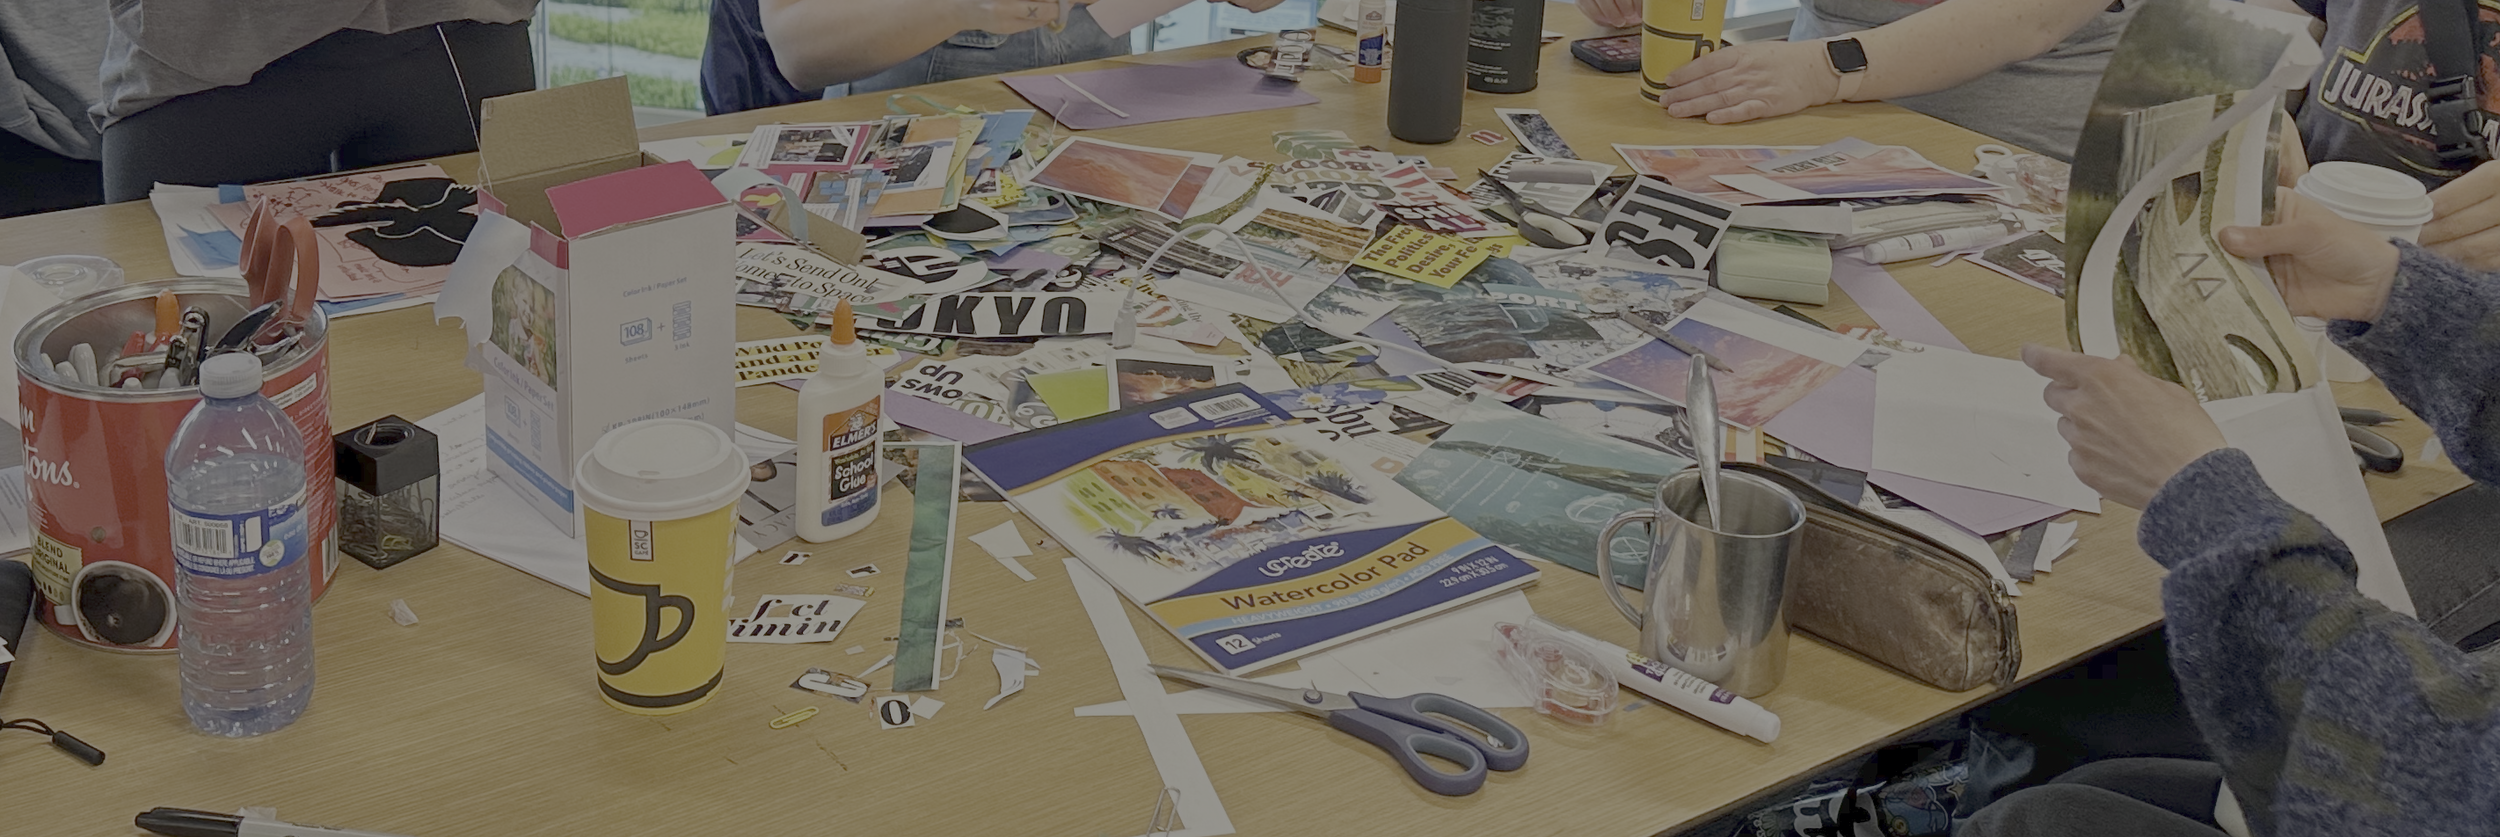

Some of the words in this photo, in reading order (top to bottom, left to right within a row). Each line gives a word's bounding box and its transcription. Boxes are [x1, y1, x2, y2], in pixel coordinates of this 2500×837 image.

[1362, 243, 1393, 262] The
[1384, 234, 1434, 268] Politics
[1406, 243, 1456, 274] Desire,
[740, 248, 786, 265] Let's
[786, 258, 842, 280] Send
[1428, 255, 1465, 279] Your
[623, 287, 641, 298] Color
[657, 281, 676, 291] Paper
[677, 277, 687, 285] Set
[790, 277, 813, 289] to
[813, 282, 875, 303] Space
[624, 323, 644, 338] 108
[625, 353, 648, 364] Sheets
[833, 422, 877, 449] ELMER'S
[835, 452, 873, 480] School
[840, 474, 866, 492] Glue
[37, 536, 63, 558] BLEND
[634, 541, 648, 550] SC
[1220, 565, 1382, 611] Watercolor
[1377, 541, 1430, 570] Pad
[1439, 575, 1460, 588] 22.9
[1479, 567, 1495, 578] 30.5
[1451, 566, 1460, 576] 9
[1478, 558, 1489, 568] 12
[1232, 603, 1322, 625] HEAVYWEIGHT
[1409, 565, 1430, 580] ACID
[1429, 553, 1454, 570] FREE
[1225, 638, 1248, 650] 12
[1252, 632, 1282, 645] Sheets
